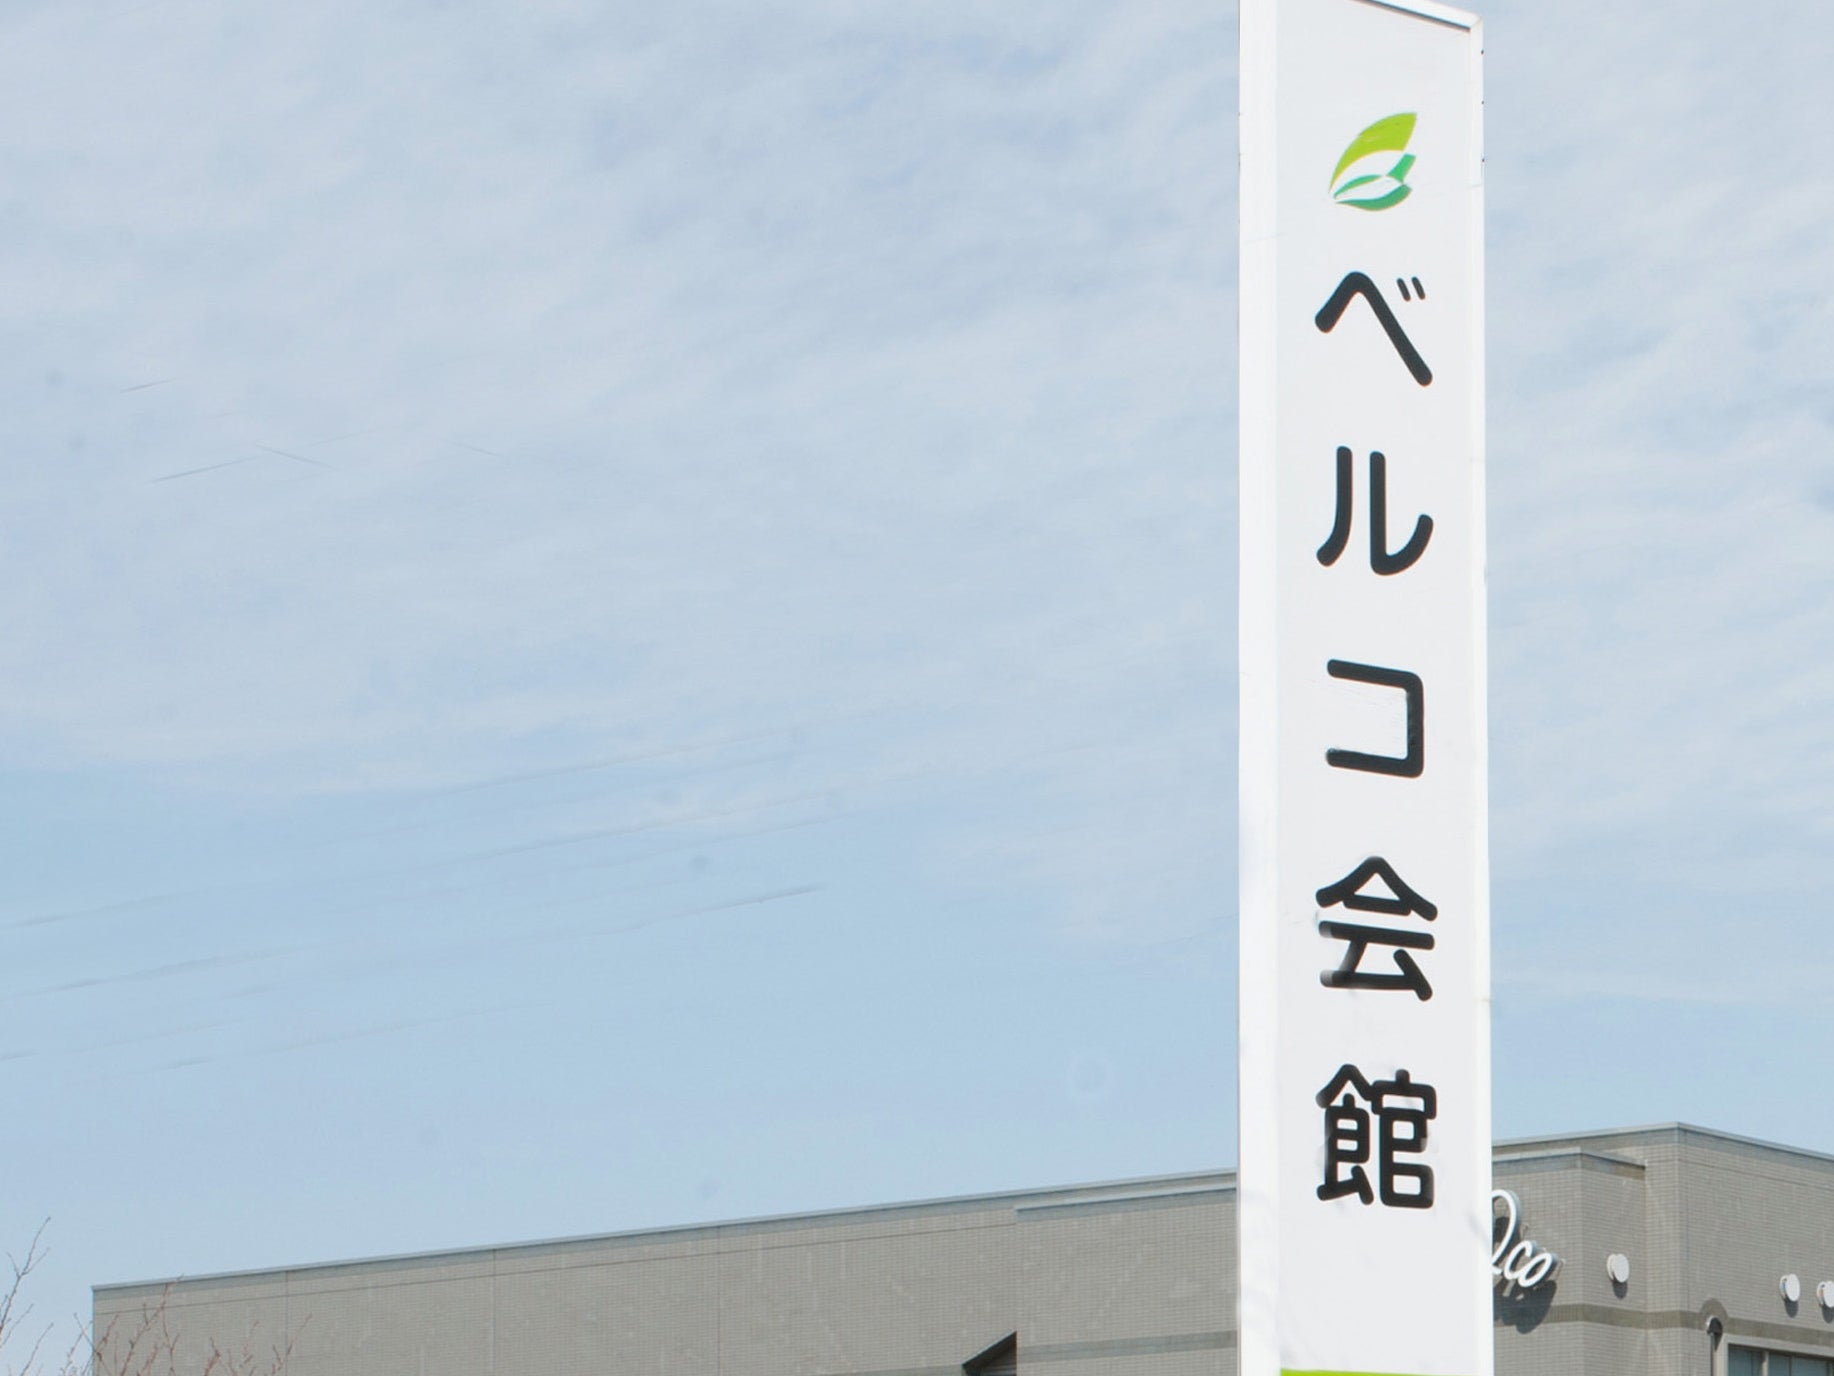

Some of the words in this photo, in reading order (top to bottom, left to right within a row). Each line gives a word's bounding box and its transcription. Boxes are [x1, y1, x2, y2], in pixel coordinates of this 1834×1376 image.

[1314, 271, 1437, 1208] ベルコ会館
